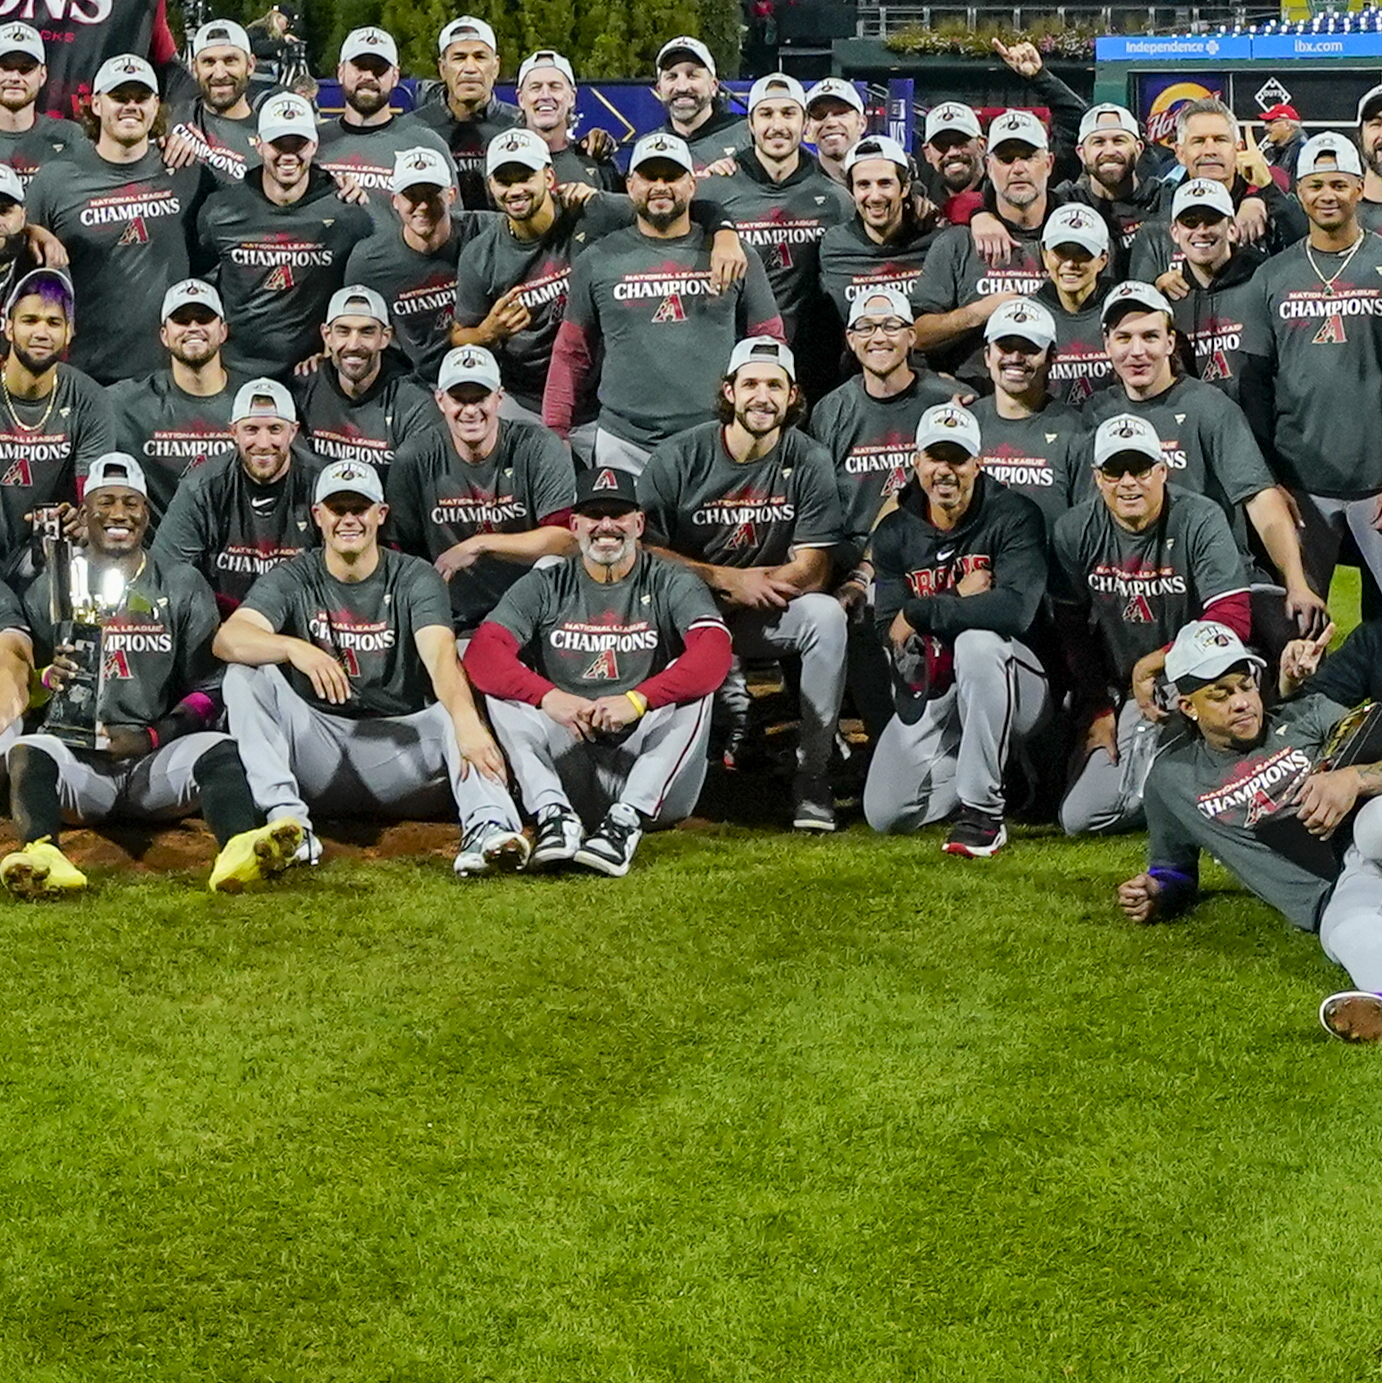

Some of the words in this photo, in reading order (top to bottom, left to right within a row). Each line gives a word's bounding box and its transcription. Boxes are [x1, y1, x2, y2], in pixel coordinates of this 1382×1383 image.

[1126, 40, 1204, 56] Independence
[1294, 40, 1343, 53] ibx.com
[90, 194, 134, 207] NATIONAL
[134, 190, 173, 202] LEAGUE
[80, 198, 180, 228] CHAMPIONS
[231, 247, 333, 268] CHAMPIONS
[25, 432, 66, 443] LEAGUE
[143, 440, 237, 458] CHAMPION
[430, 501, 527, 525] CHAMPIONS
[692, 502, 795, 527] CHAMPIONS
[1088, 573, 1187, 596] CHAMPIONS
[550, 629, 658, 652] CHAMPIONS
[1197, 747, 1312, 819] CHAMPIONS
